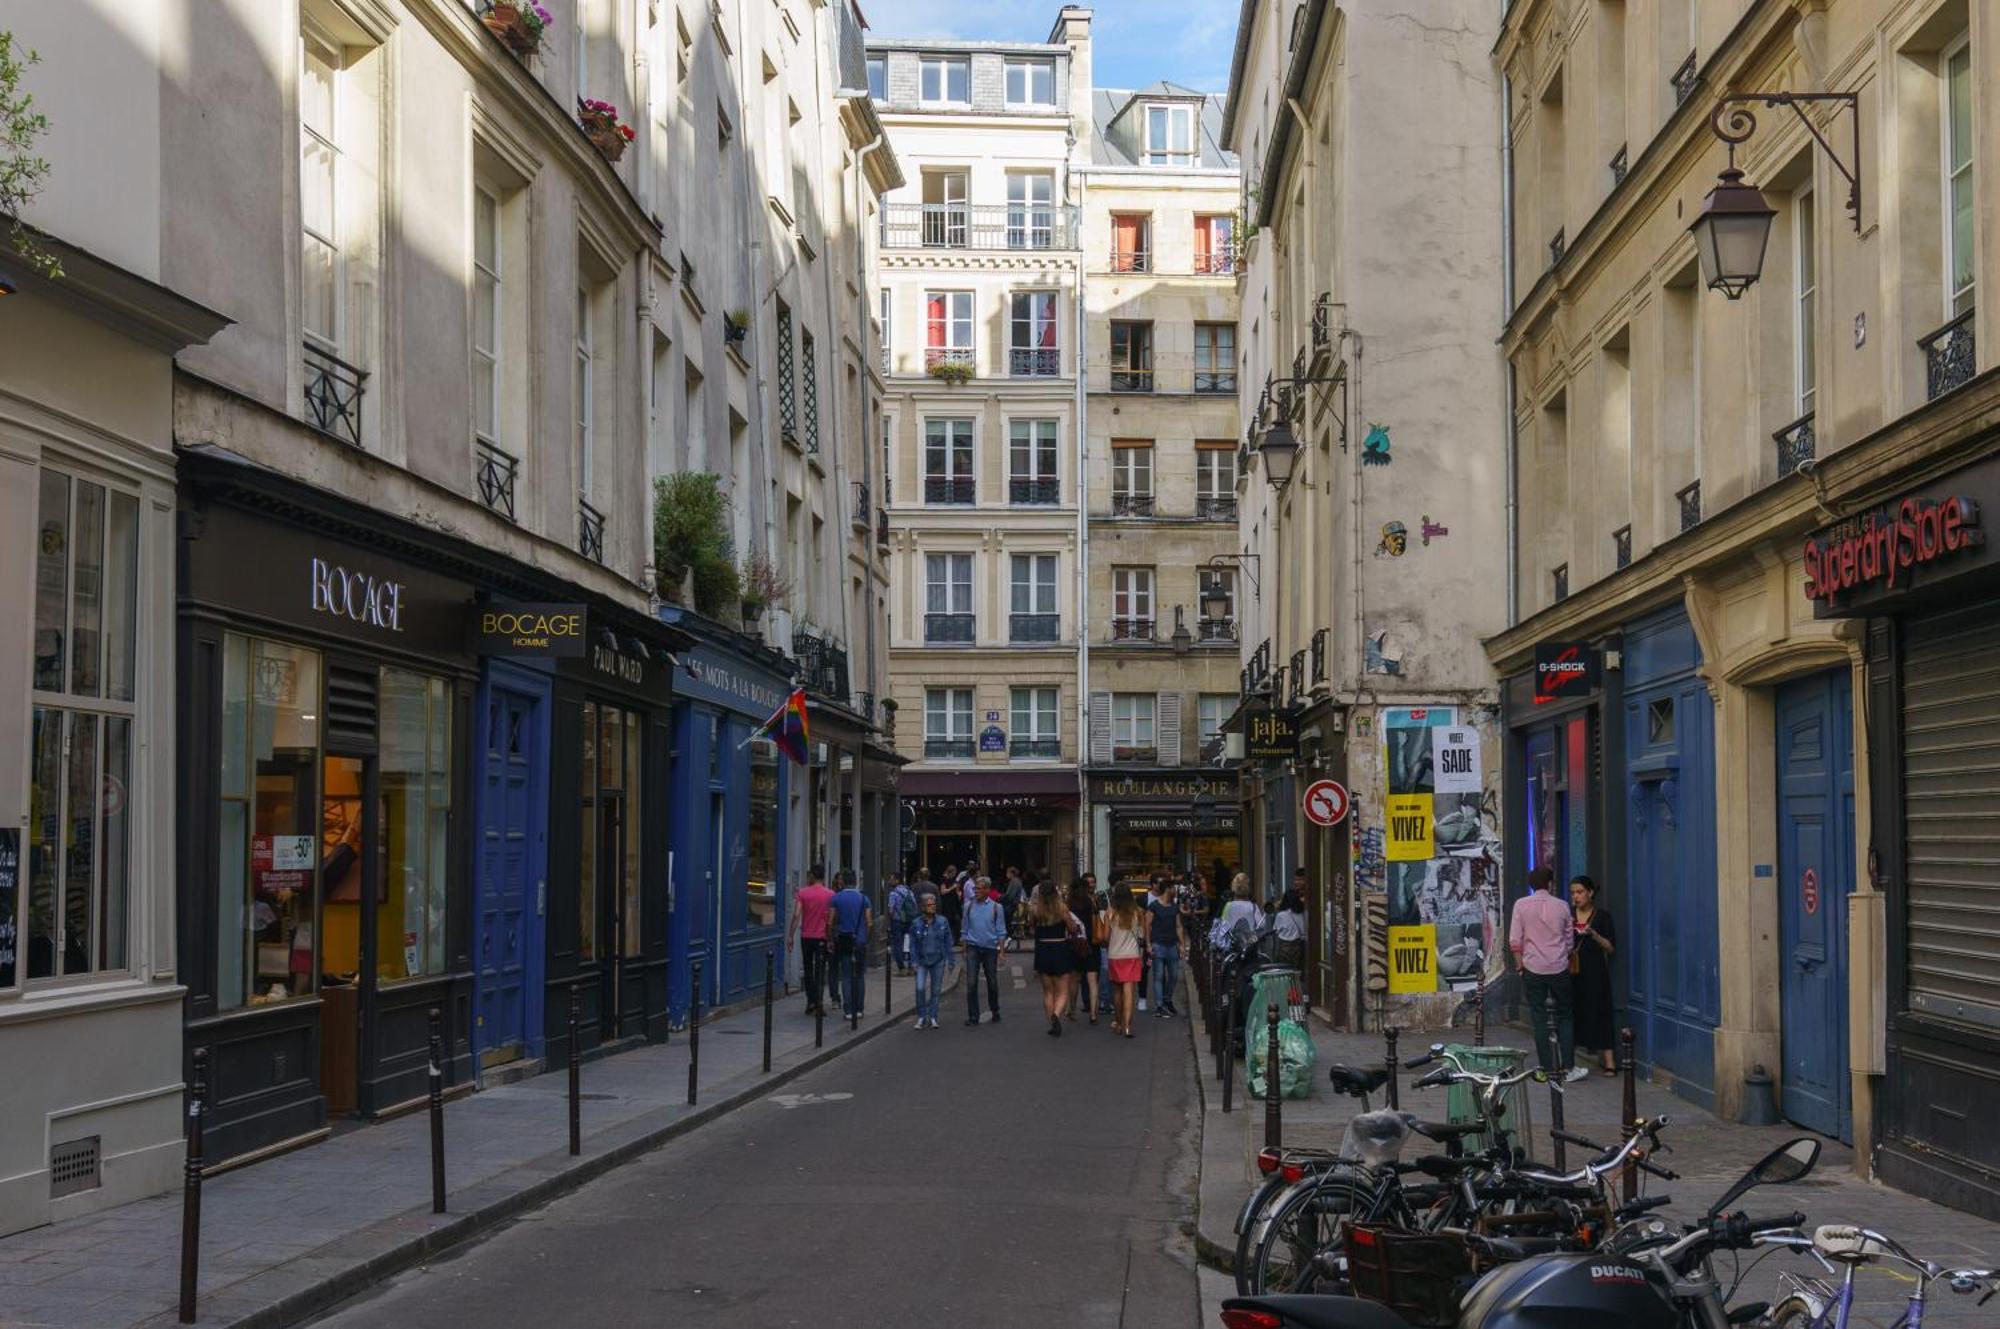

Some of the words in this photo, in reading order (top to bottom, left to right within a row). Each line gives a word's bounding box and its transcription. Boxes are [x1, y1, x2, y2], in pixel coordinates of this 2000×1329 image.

[312, 557, 407, 632] BOCAGE
[482, 613, 580, 635] BOCAGE
[512, 638, 550, 647] HOMME
[594, 645, 615, 675] PAUL
[618, 654, 642, 684] WARD
[1539, 662, 1585, 672] G-SHOCK
[705, 663, 729, 691] MOTS
[739, 677, 749, 698] LA
[1441, 749, 1472, 773] SADE
[1129, 820, 1167, 828] TRAITEUR
[1222, 819, 1234, 827] DE
[1392, 816, 1426, 841] VIVEZ
[1395, 948, 1429, 973] VIVEZ
[1590, 1264, 1646, 1281] DUCATI
